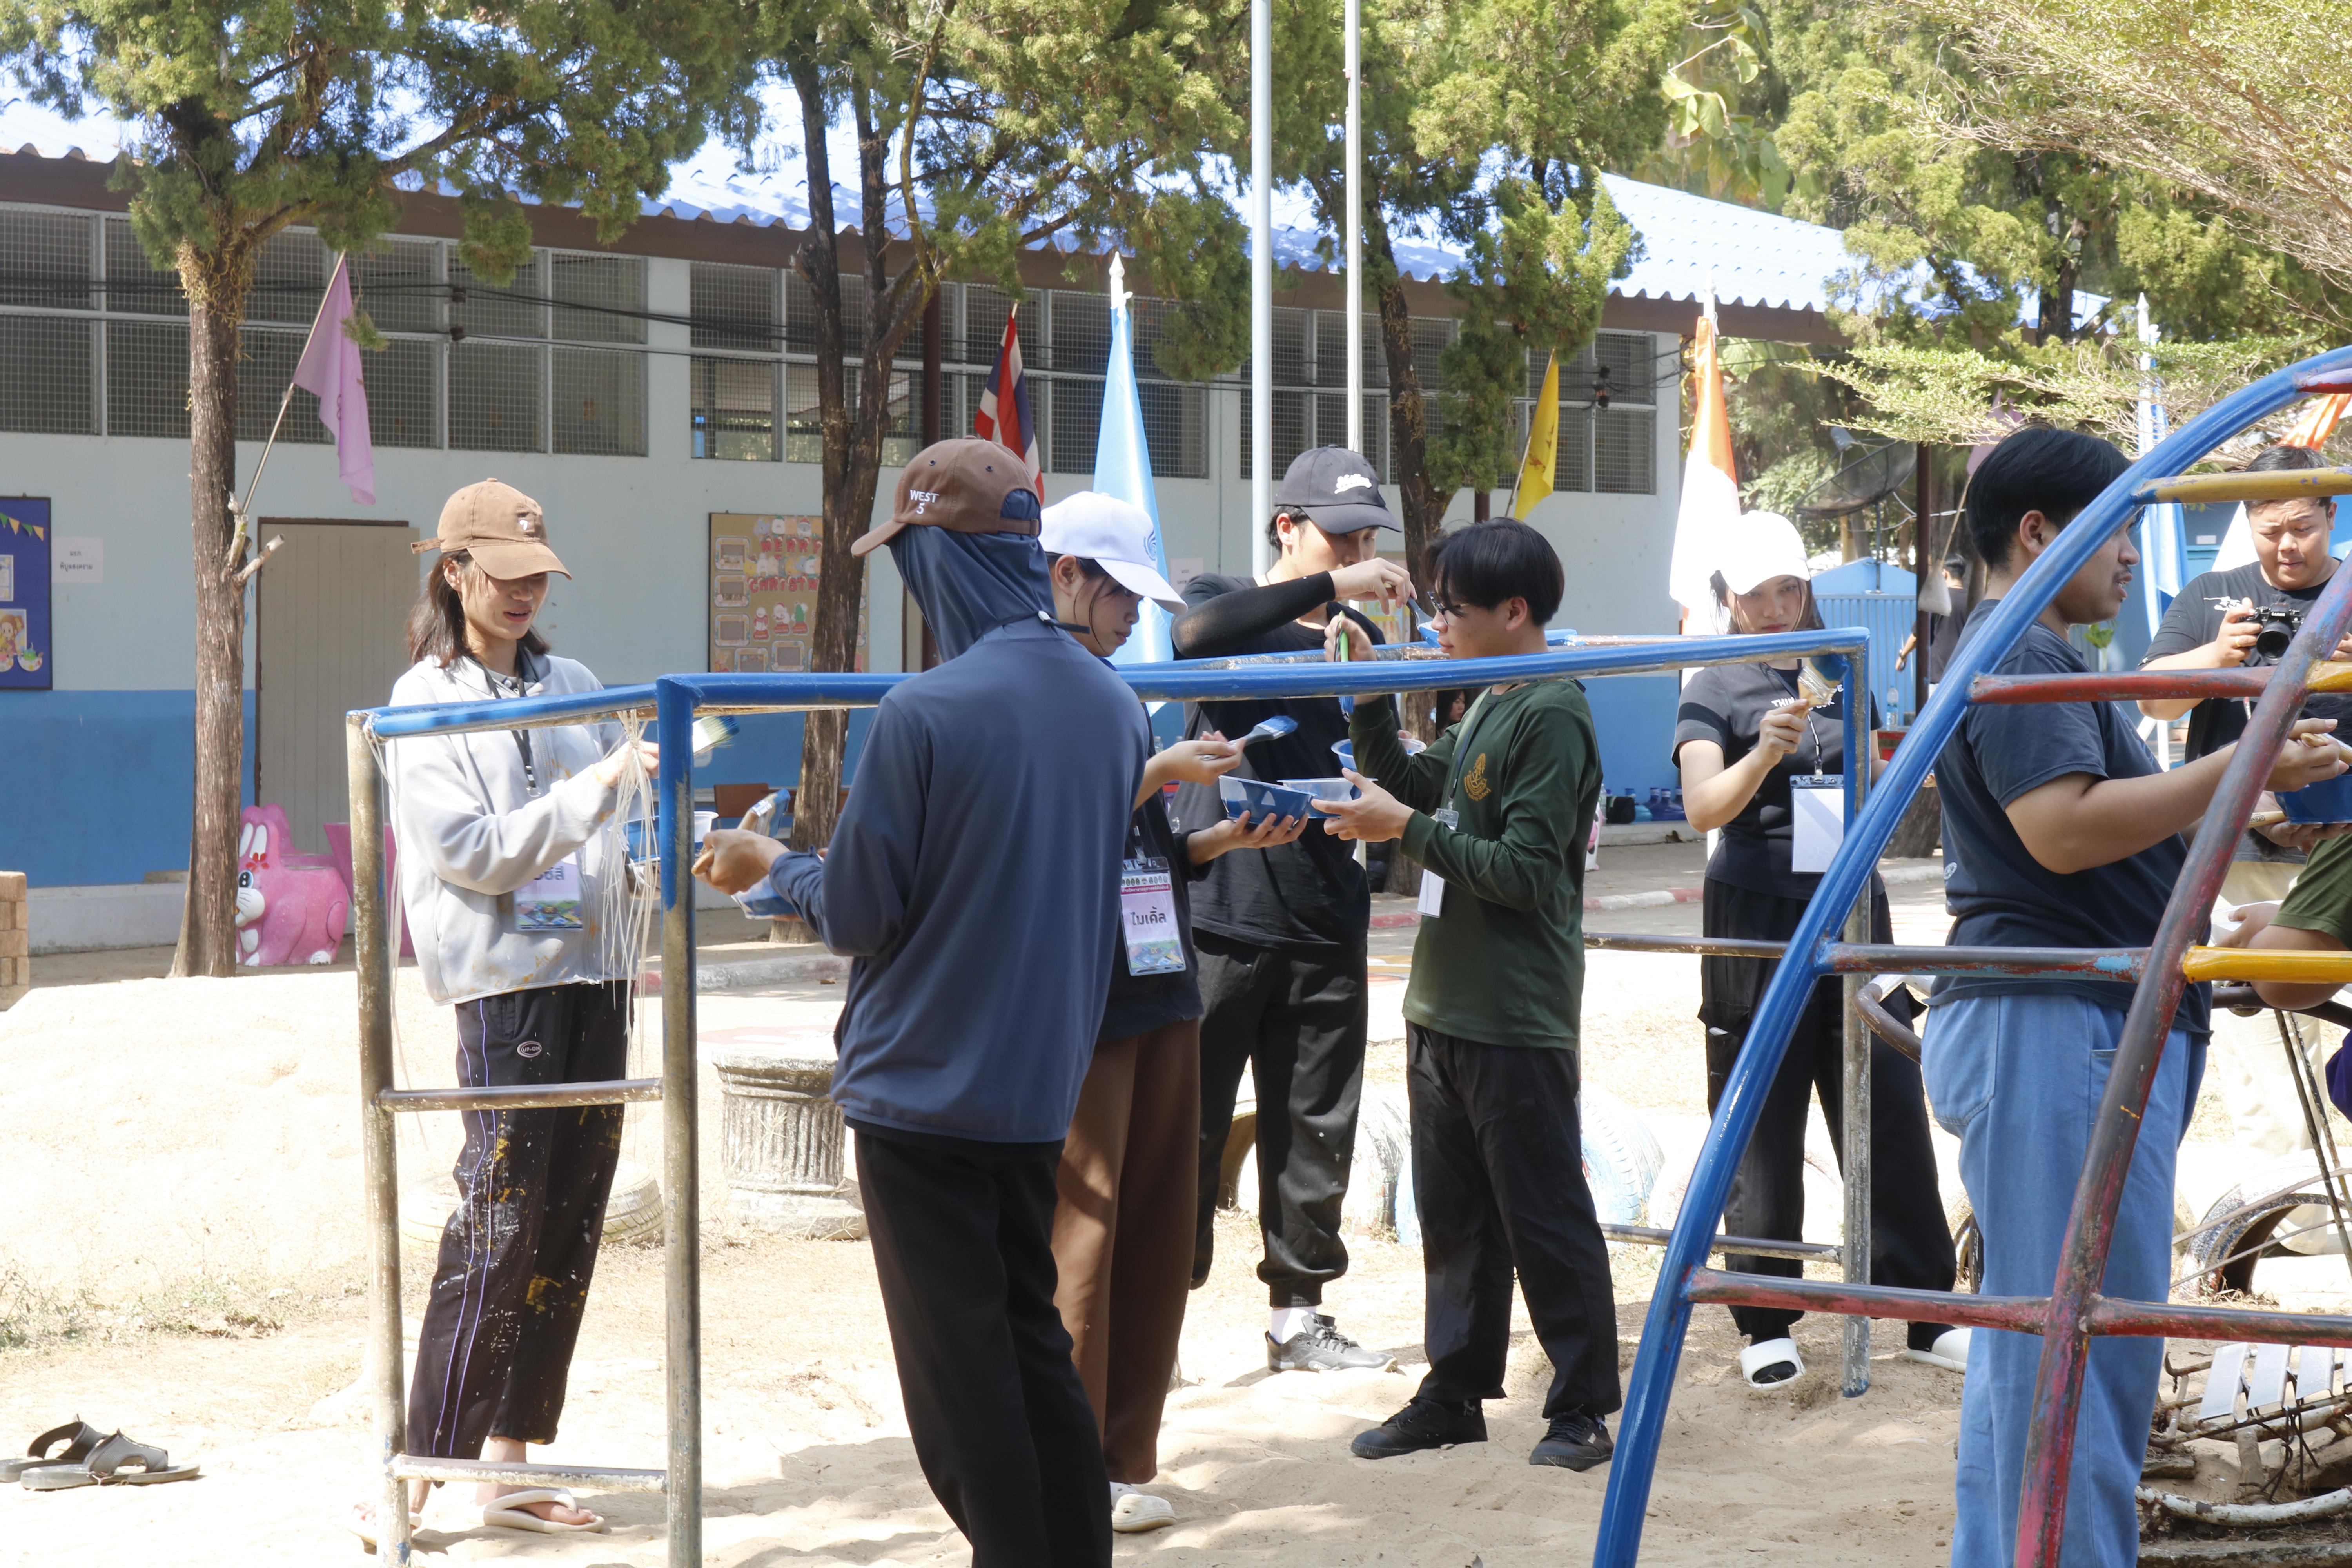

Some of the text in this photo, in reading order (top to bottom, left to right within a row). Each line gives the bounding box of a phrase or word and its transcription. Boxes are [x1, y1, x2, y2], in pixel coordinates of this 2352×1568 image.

[910, 489, 940, 503] WEST
[916, 503, 925, 514] 5
[761, 537, 822, 554] MERRY
[748, 575, 820, 593] CHRISTM
